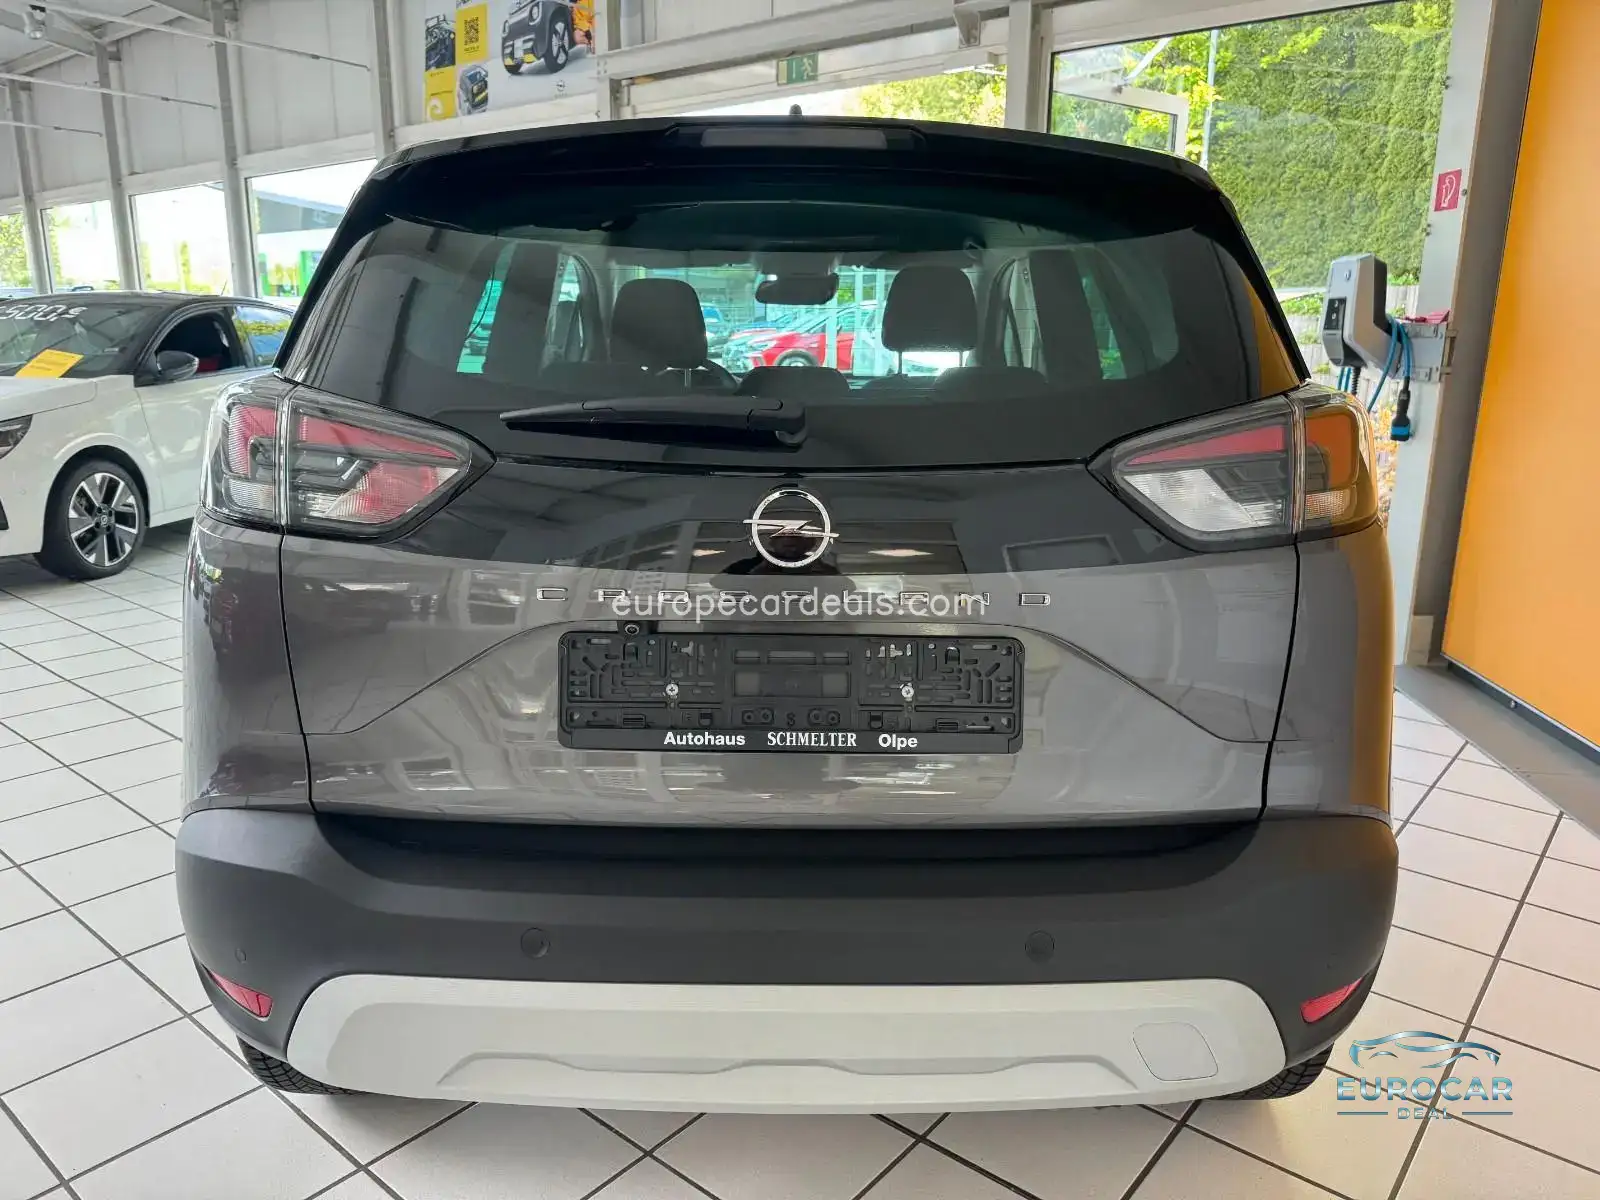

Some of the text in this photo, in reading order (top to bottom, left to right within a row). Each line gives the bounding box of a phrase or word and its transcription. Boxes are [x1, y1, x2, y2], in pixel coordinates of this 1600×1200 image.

[663, 731, 918, 750] Autohaus SCHMELTER Olpe
